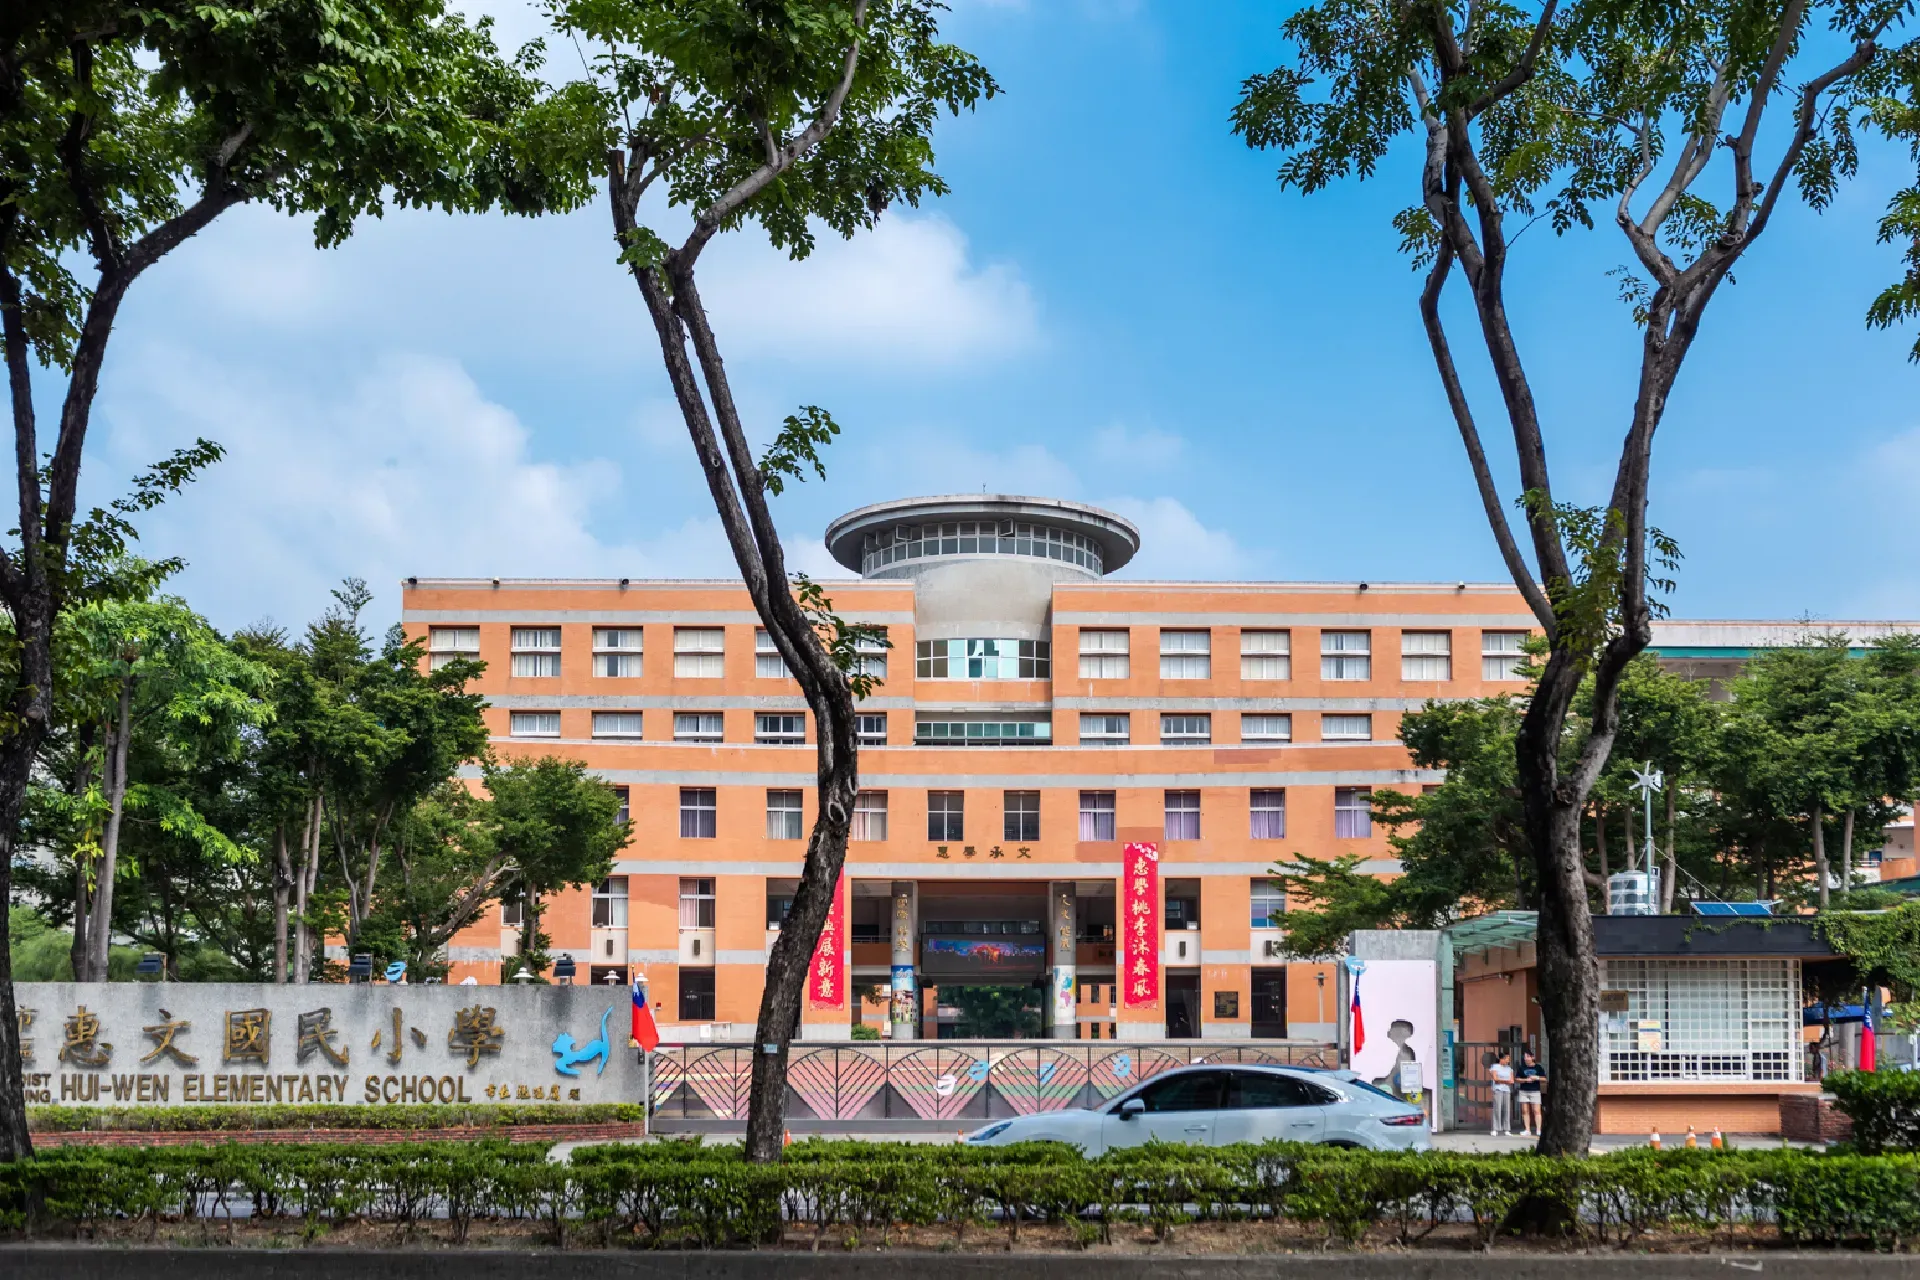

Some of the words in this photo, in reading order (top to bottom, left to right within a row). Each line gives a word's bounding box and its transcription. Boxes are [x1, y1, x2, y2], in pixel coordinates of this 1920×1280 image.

[1131, 856, 1151, 997] 惠學桃李沐春風
[58, 1003, 505, 1067] 惠文國民小學
[60, 1073, 170, 1102] HUI-WEN
[183, 1074, 349, 1102] ELEMENTARY
[364, 1074, 472, 1103] SCHOOL
